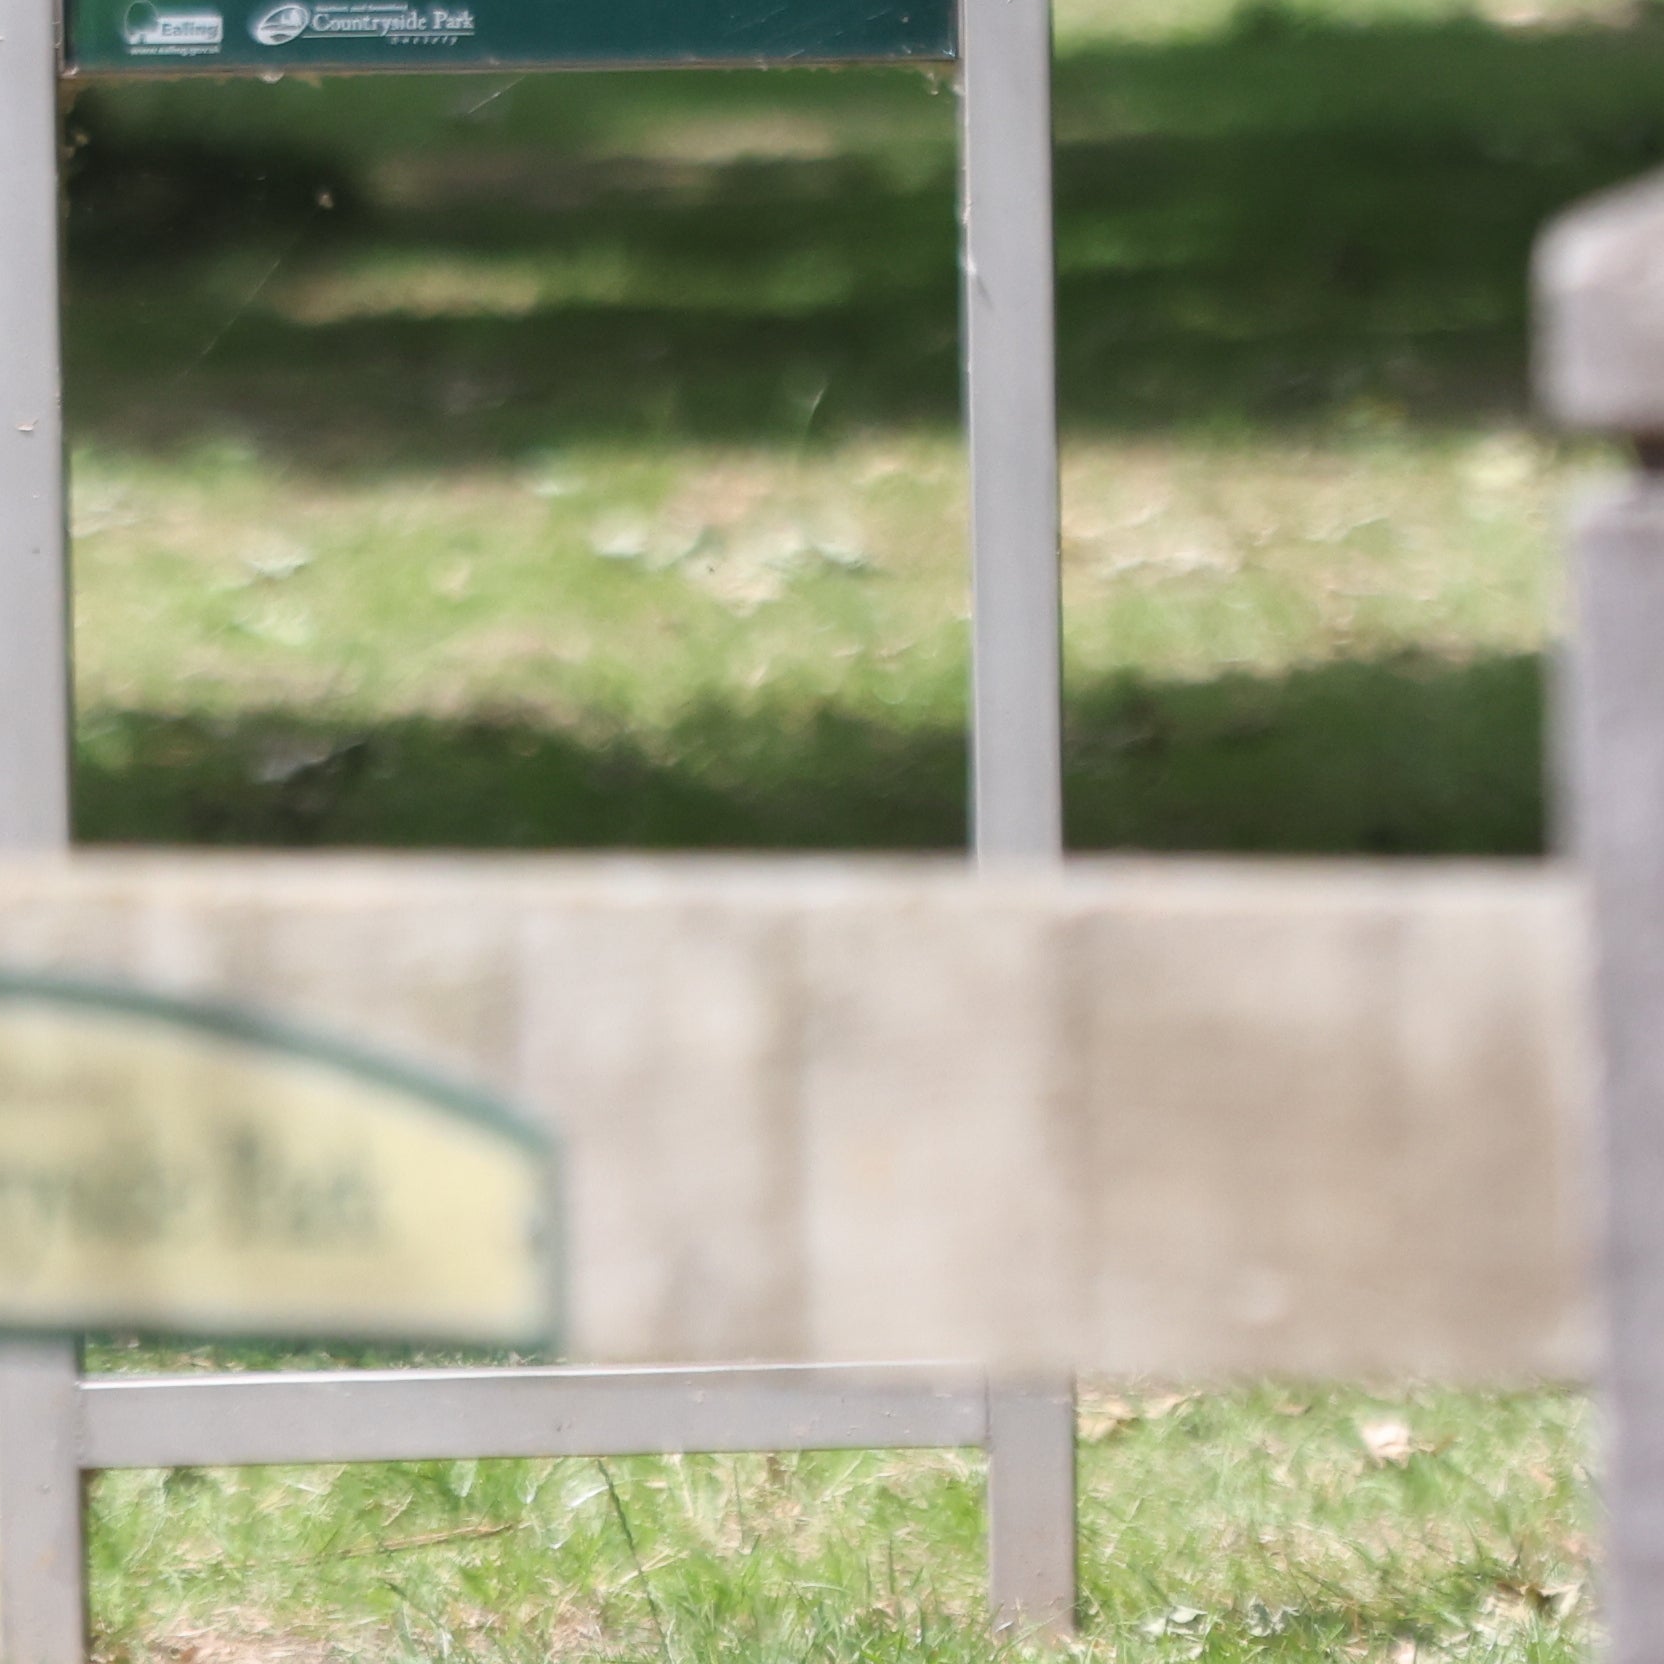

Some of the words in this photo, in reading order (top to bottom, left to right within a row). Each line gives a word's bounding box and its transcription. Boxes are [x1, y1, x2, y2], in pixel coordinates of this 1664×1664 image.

[161, 22, 220, 40] Ealing
[311, 12, 427, 37] Countryside
[431, 9, 475, 30] Park
